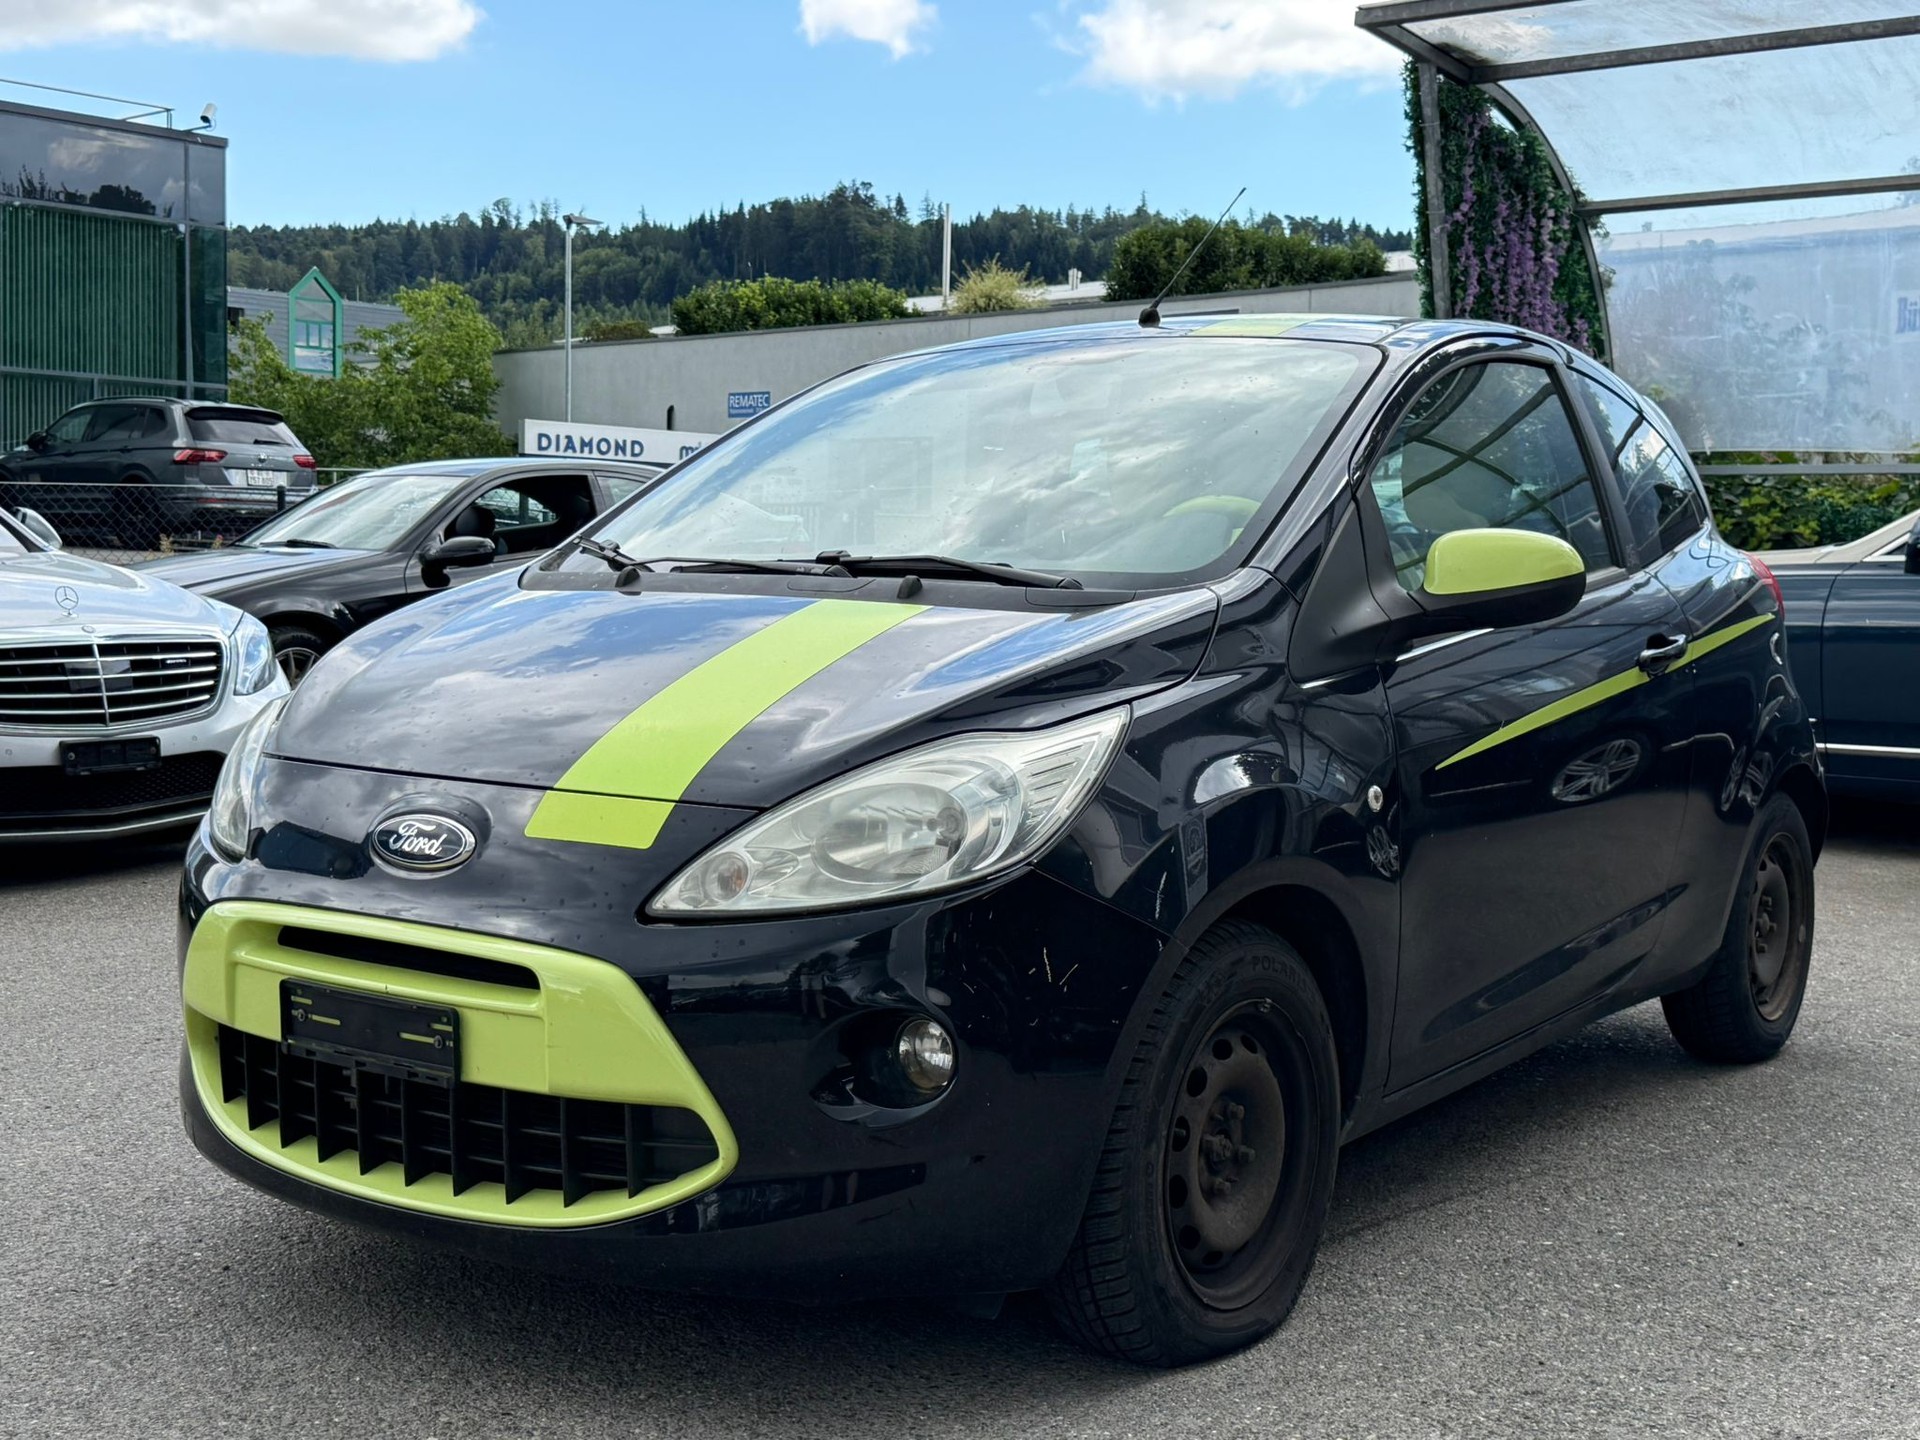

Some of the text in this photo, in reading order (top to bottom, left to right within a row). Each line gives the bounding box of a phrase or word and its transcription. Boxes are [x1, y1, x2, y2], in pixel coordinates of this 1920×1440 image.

[1896, 297, 1920, 333] Bü
[729, 394, 769, 408] REMATEC
[537, 432, 644, 458] DIAMOND
[388, 820, 447, 856] Ford
